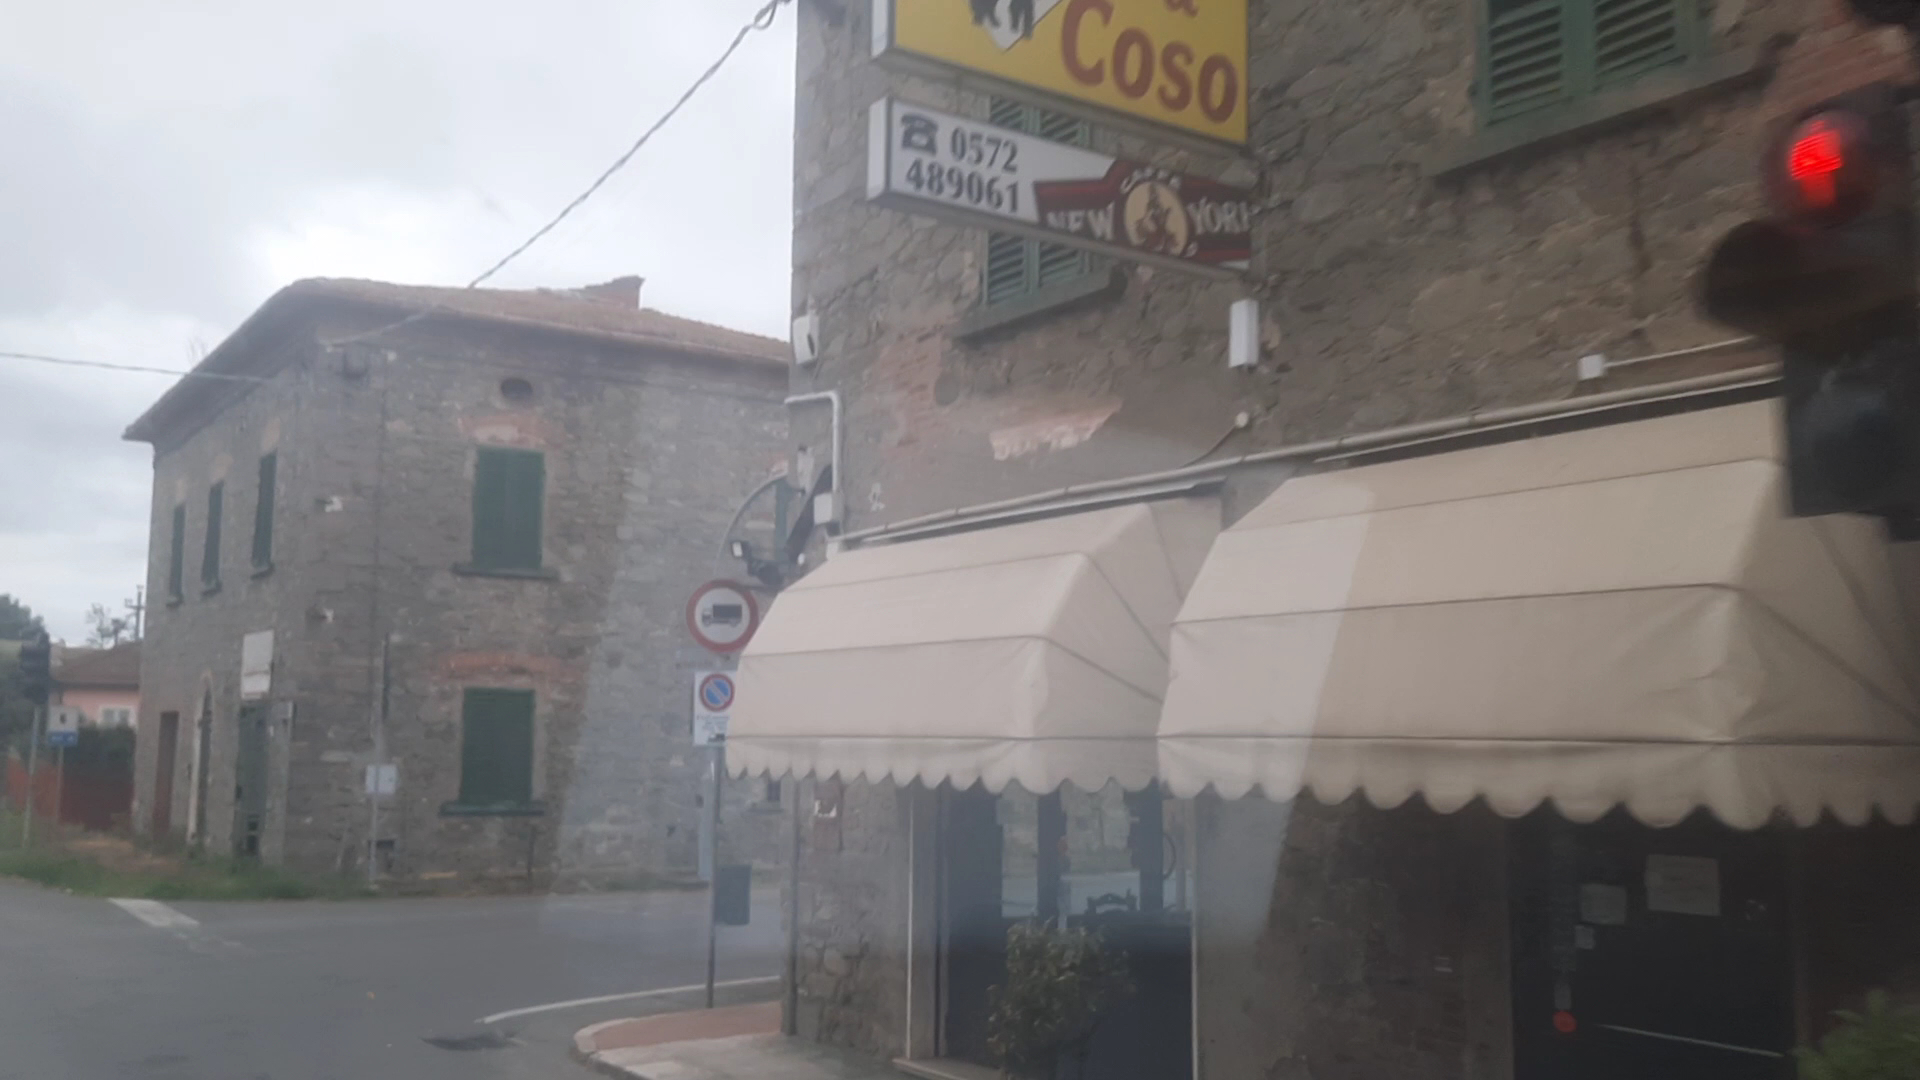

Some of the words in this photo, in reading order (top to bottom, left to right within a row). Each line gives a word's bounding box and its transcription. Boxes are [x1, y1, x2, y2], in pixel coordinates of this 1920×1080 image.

[951, 126, 1018, 173] 0572
[906, 157, 1018, 213] 489061
[1047, 201, 1116, 241] NEW
